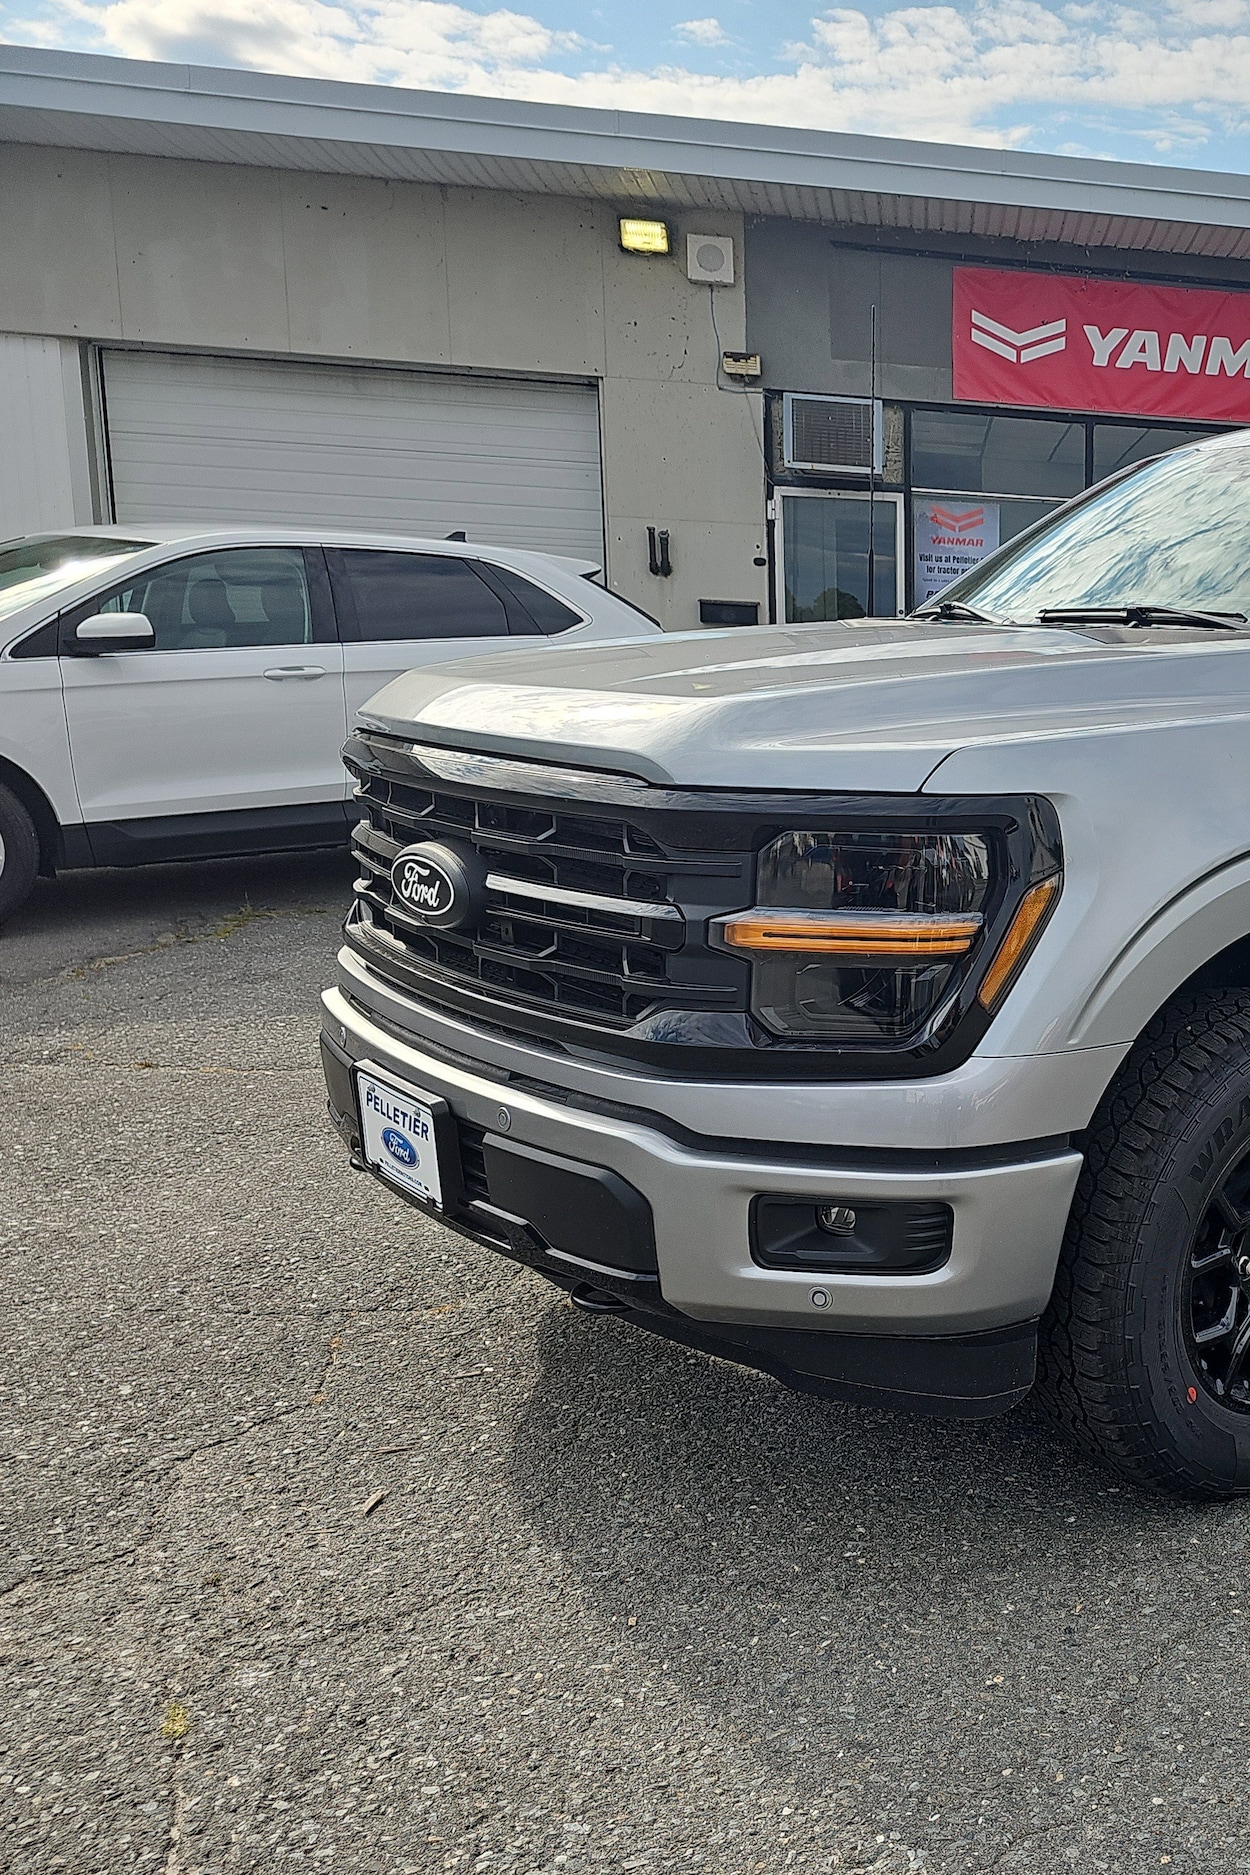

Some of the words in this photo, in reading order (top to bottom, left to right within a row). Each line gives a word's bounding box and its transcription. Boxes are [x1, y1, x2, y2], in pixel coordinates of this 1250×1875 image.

[930, 535, 984, 548] YANMAR
[918, 553, 933, 563] Visit
[934, 555, 943, 563] us
[944, 555, 951, 564] at
[926, 565, 936, 574] for
[937, 565, 960, 575] tractor
[401, 862, 441, 908] Ford
[366, 1090, 430, 1141] PELLETIER
[388, 1132, 411, 1163] Ford
